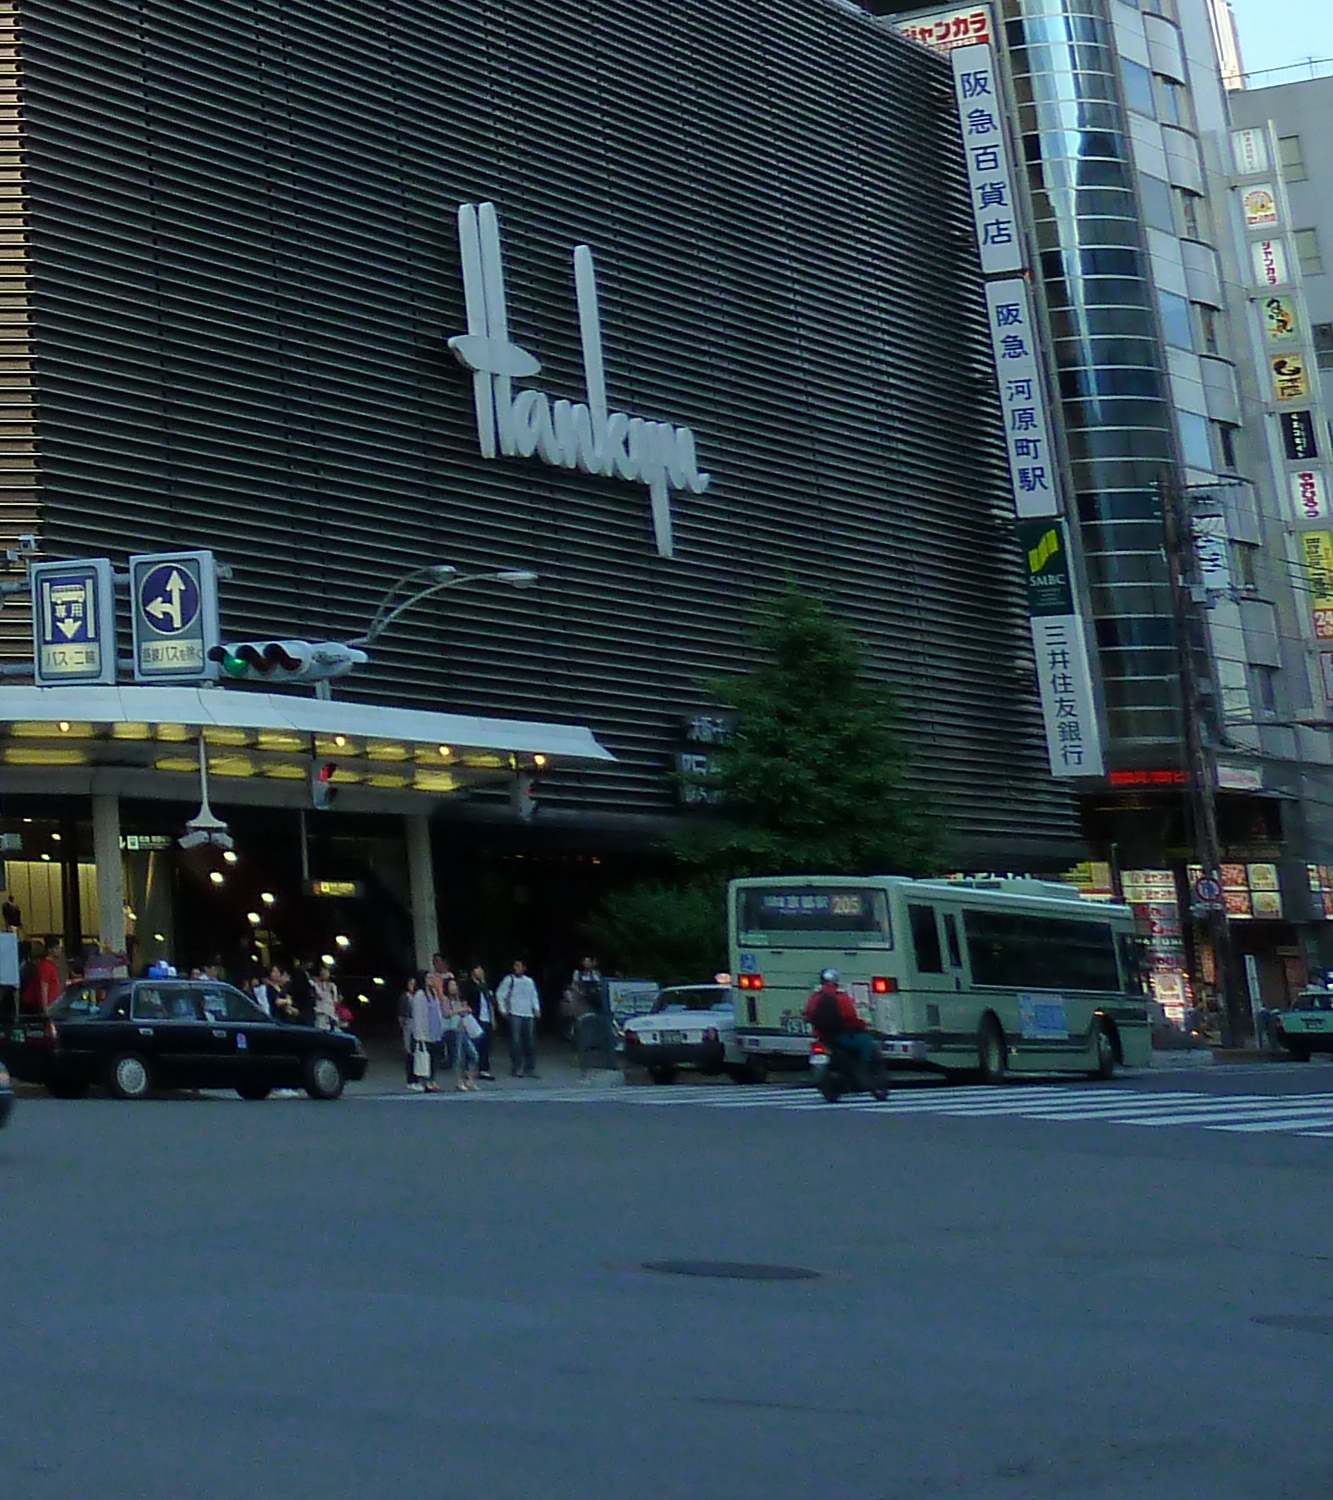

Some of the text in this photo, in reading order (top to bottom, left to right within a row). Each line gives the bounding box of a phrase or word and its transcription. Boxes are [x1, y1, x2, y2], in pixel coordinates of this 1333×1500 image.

[959, 68, 1014, 248] 阪急百貨店
[447, 202, 711, 557] Hankyu
[1029, 573, 1066, 588] SMBC
[1043, 624, 1084, 768] 三井住友銀行
